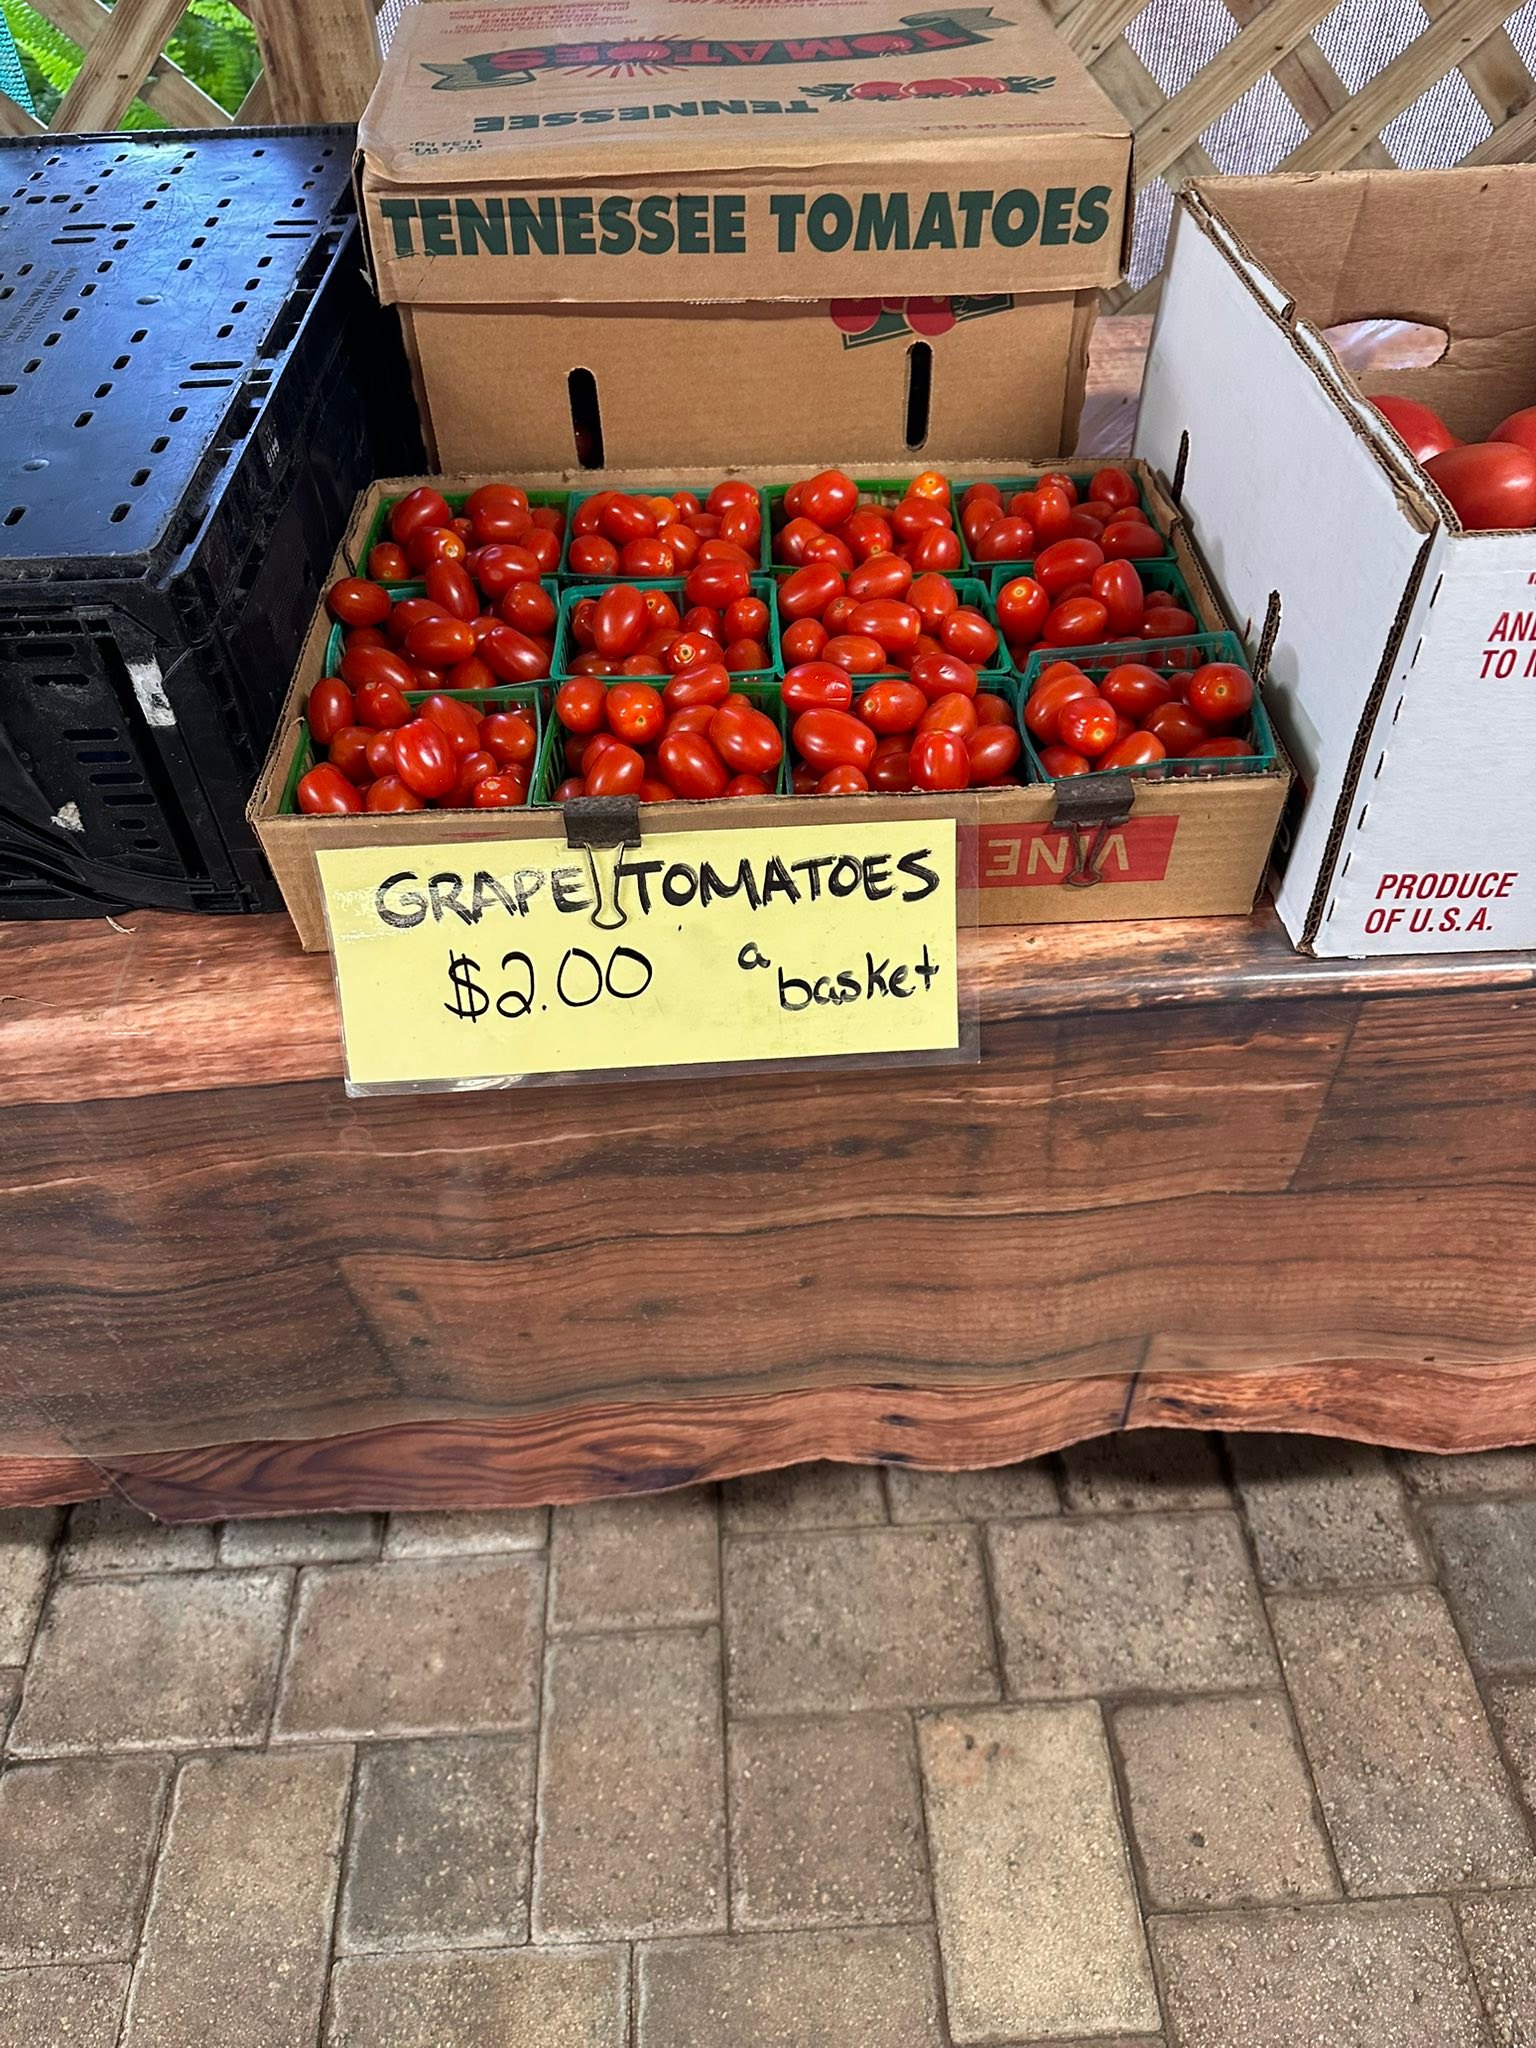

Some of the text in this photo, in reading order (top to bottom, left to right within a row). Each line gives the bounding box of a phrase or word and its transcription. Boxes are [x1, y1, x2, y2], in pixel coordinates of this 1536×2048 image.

[488, 27, 973, 70] TOMATOES
[473, 100, 820, 133] TENNESSEE
[379, 185, 1113, 255] TENNESSEE TOMATOES
[1487, 611, 1536, 642] AN
[1480, 648, 1518, 679] TO
[374, 848, 942, 928] GRAPE TOMATOES
[1375, 872, 1519, 899] PRODUCE
[1364, 908, 1406, 934] OF
[443, 941, 941, 1024] $2.00 a basket
